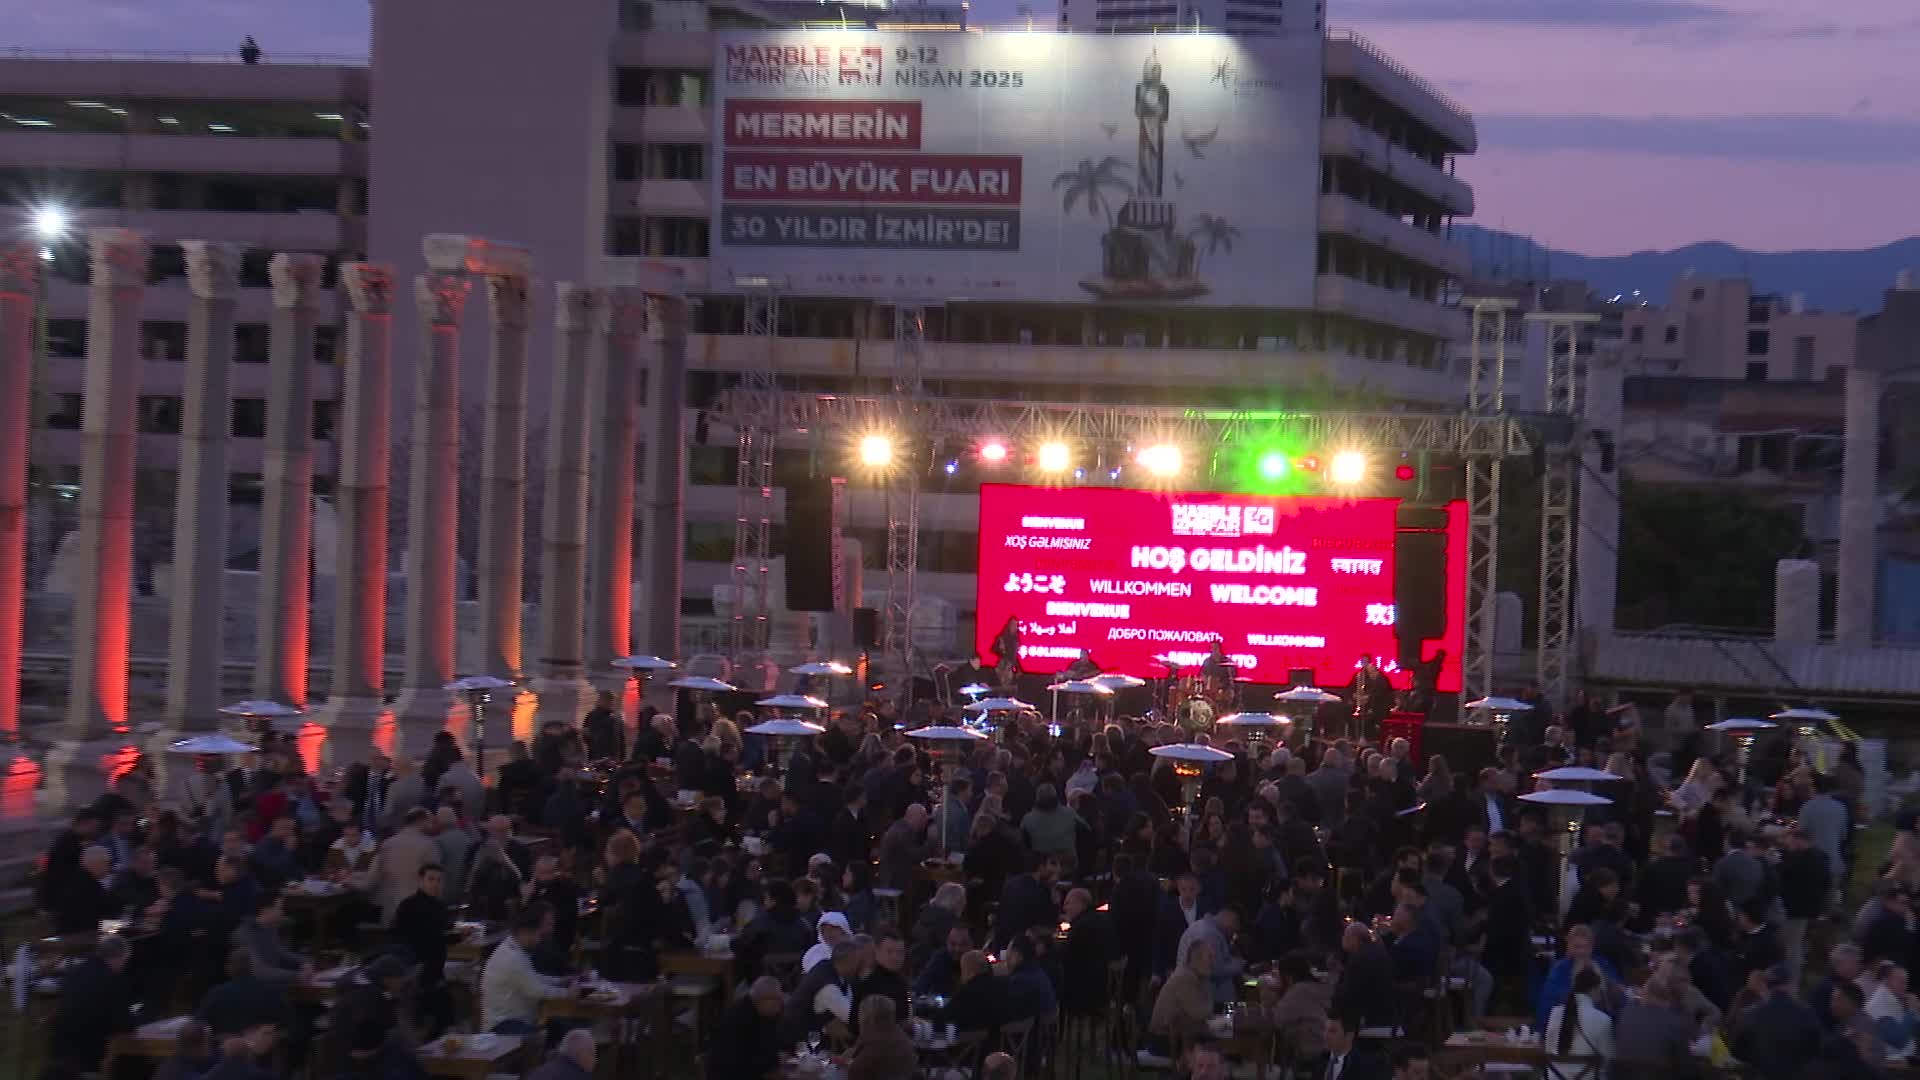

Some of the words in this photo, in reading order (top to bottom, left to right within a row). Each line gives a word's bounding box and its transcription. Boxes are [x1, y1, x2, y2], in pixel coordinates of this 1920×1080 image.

[724, 45, 832, 66] MARBLE
[895, 46, 939, 64] 9-12
[895, 67, 963, 88] NİSAN
[969, 71, 1024, 88] 2025
[734, 109, 909, 140] MERMERİN
[733, 164, 777, 191] EN
[786, 160, 901, 193] BÜYÜK
[909, 167, 1011, 196] FUARI
[731, 216, 766, 238] 30
[775, 215, 867, 241] YILDIR
[874, 213, 1010, 243] İZMİR'DE!
[1005, 535, 1027, 549] XOŞ
[1131, 546, 1186, 573] HOŞ
[1189, 545, 1306, 575] GELDİNİZ
[1004, 573, 1066, 594] ようこそ
[1090, 579, 1191, 597] WILLKOMMEN
[1210, 584, 1318, 606] WELCOME
[1108, 628, 1146, 640] ДОБРО
